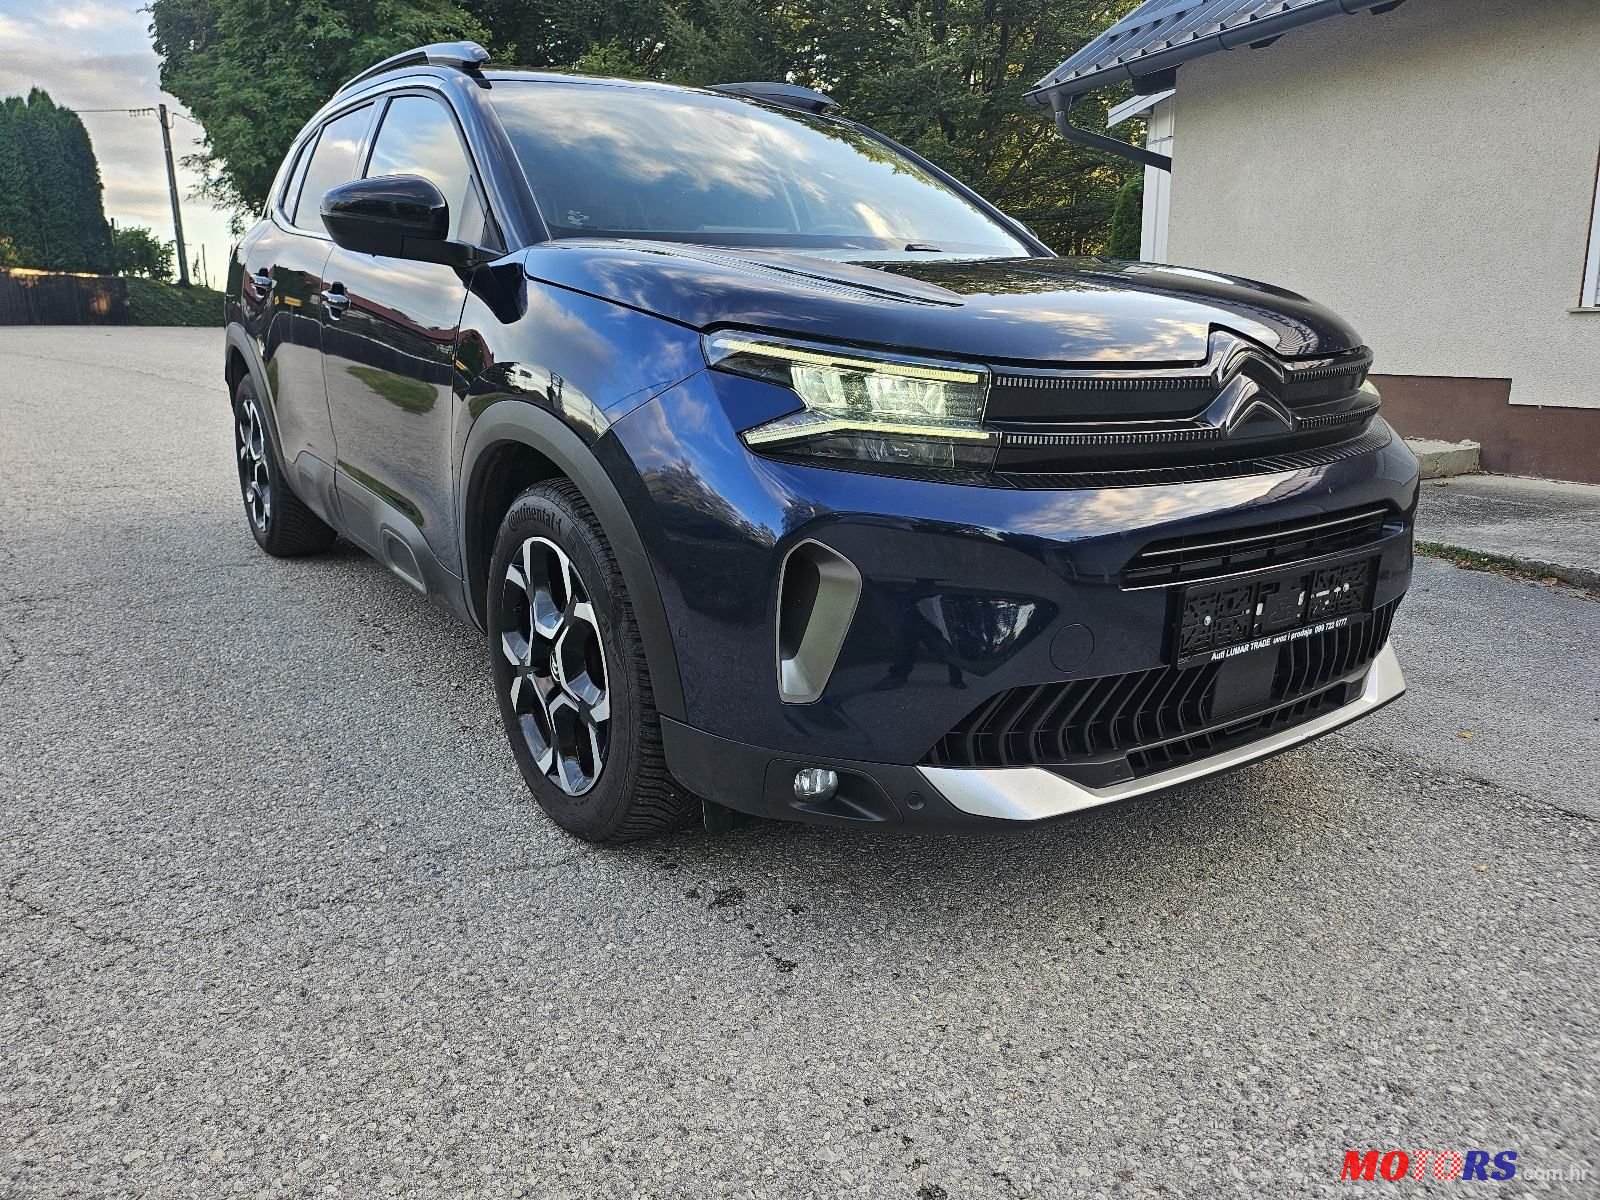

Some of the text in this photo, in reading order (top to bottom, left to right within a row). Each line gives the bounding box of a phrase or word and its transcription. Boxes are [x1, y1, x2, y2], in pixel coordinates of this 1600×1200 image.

[509, 503, 555, 531] Continental
[1226, 644, 1249, 657] LUMAR
[1251, 638, 1271, 650] TRADE
